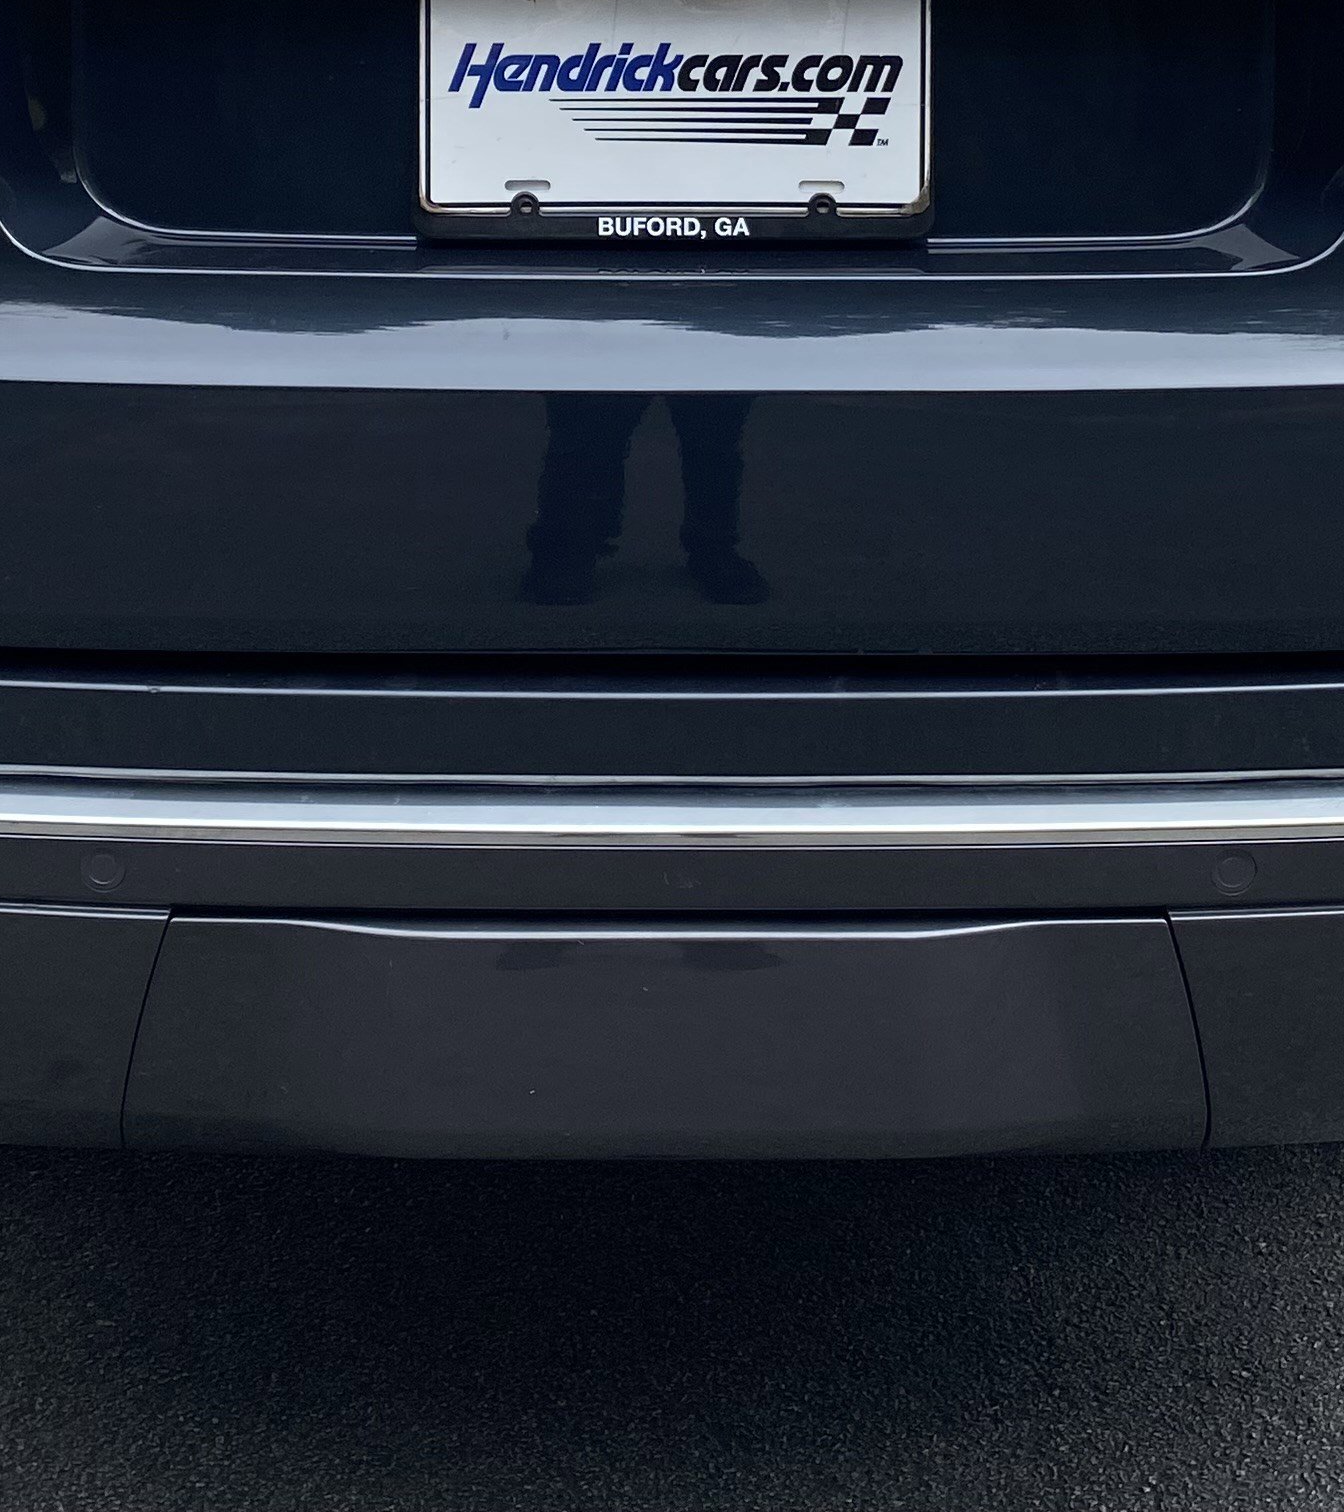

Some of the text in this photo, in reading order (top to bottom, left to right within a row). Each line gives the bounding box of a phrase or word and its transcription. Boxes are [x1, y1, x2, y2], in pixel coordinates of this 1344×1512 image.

[448, 42, 904, 109] Hendrickcars.com
[598, 217, 750, 239] BUFORD, GA
